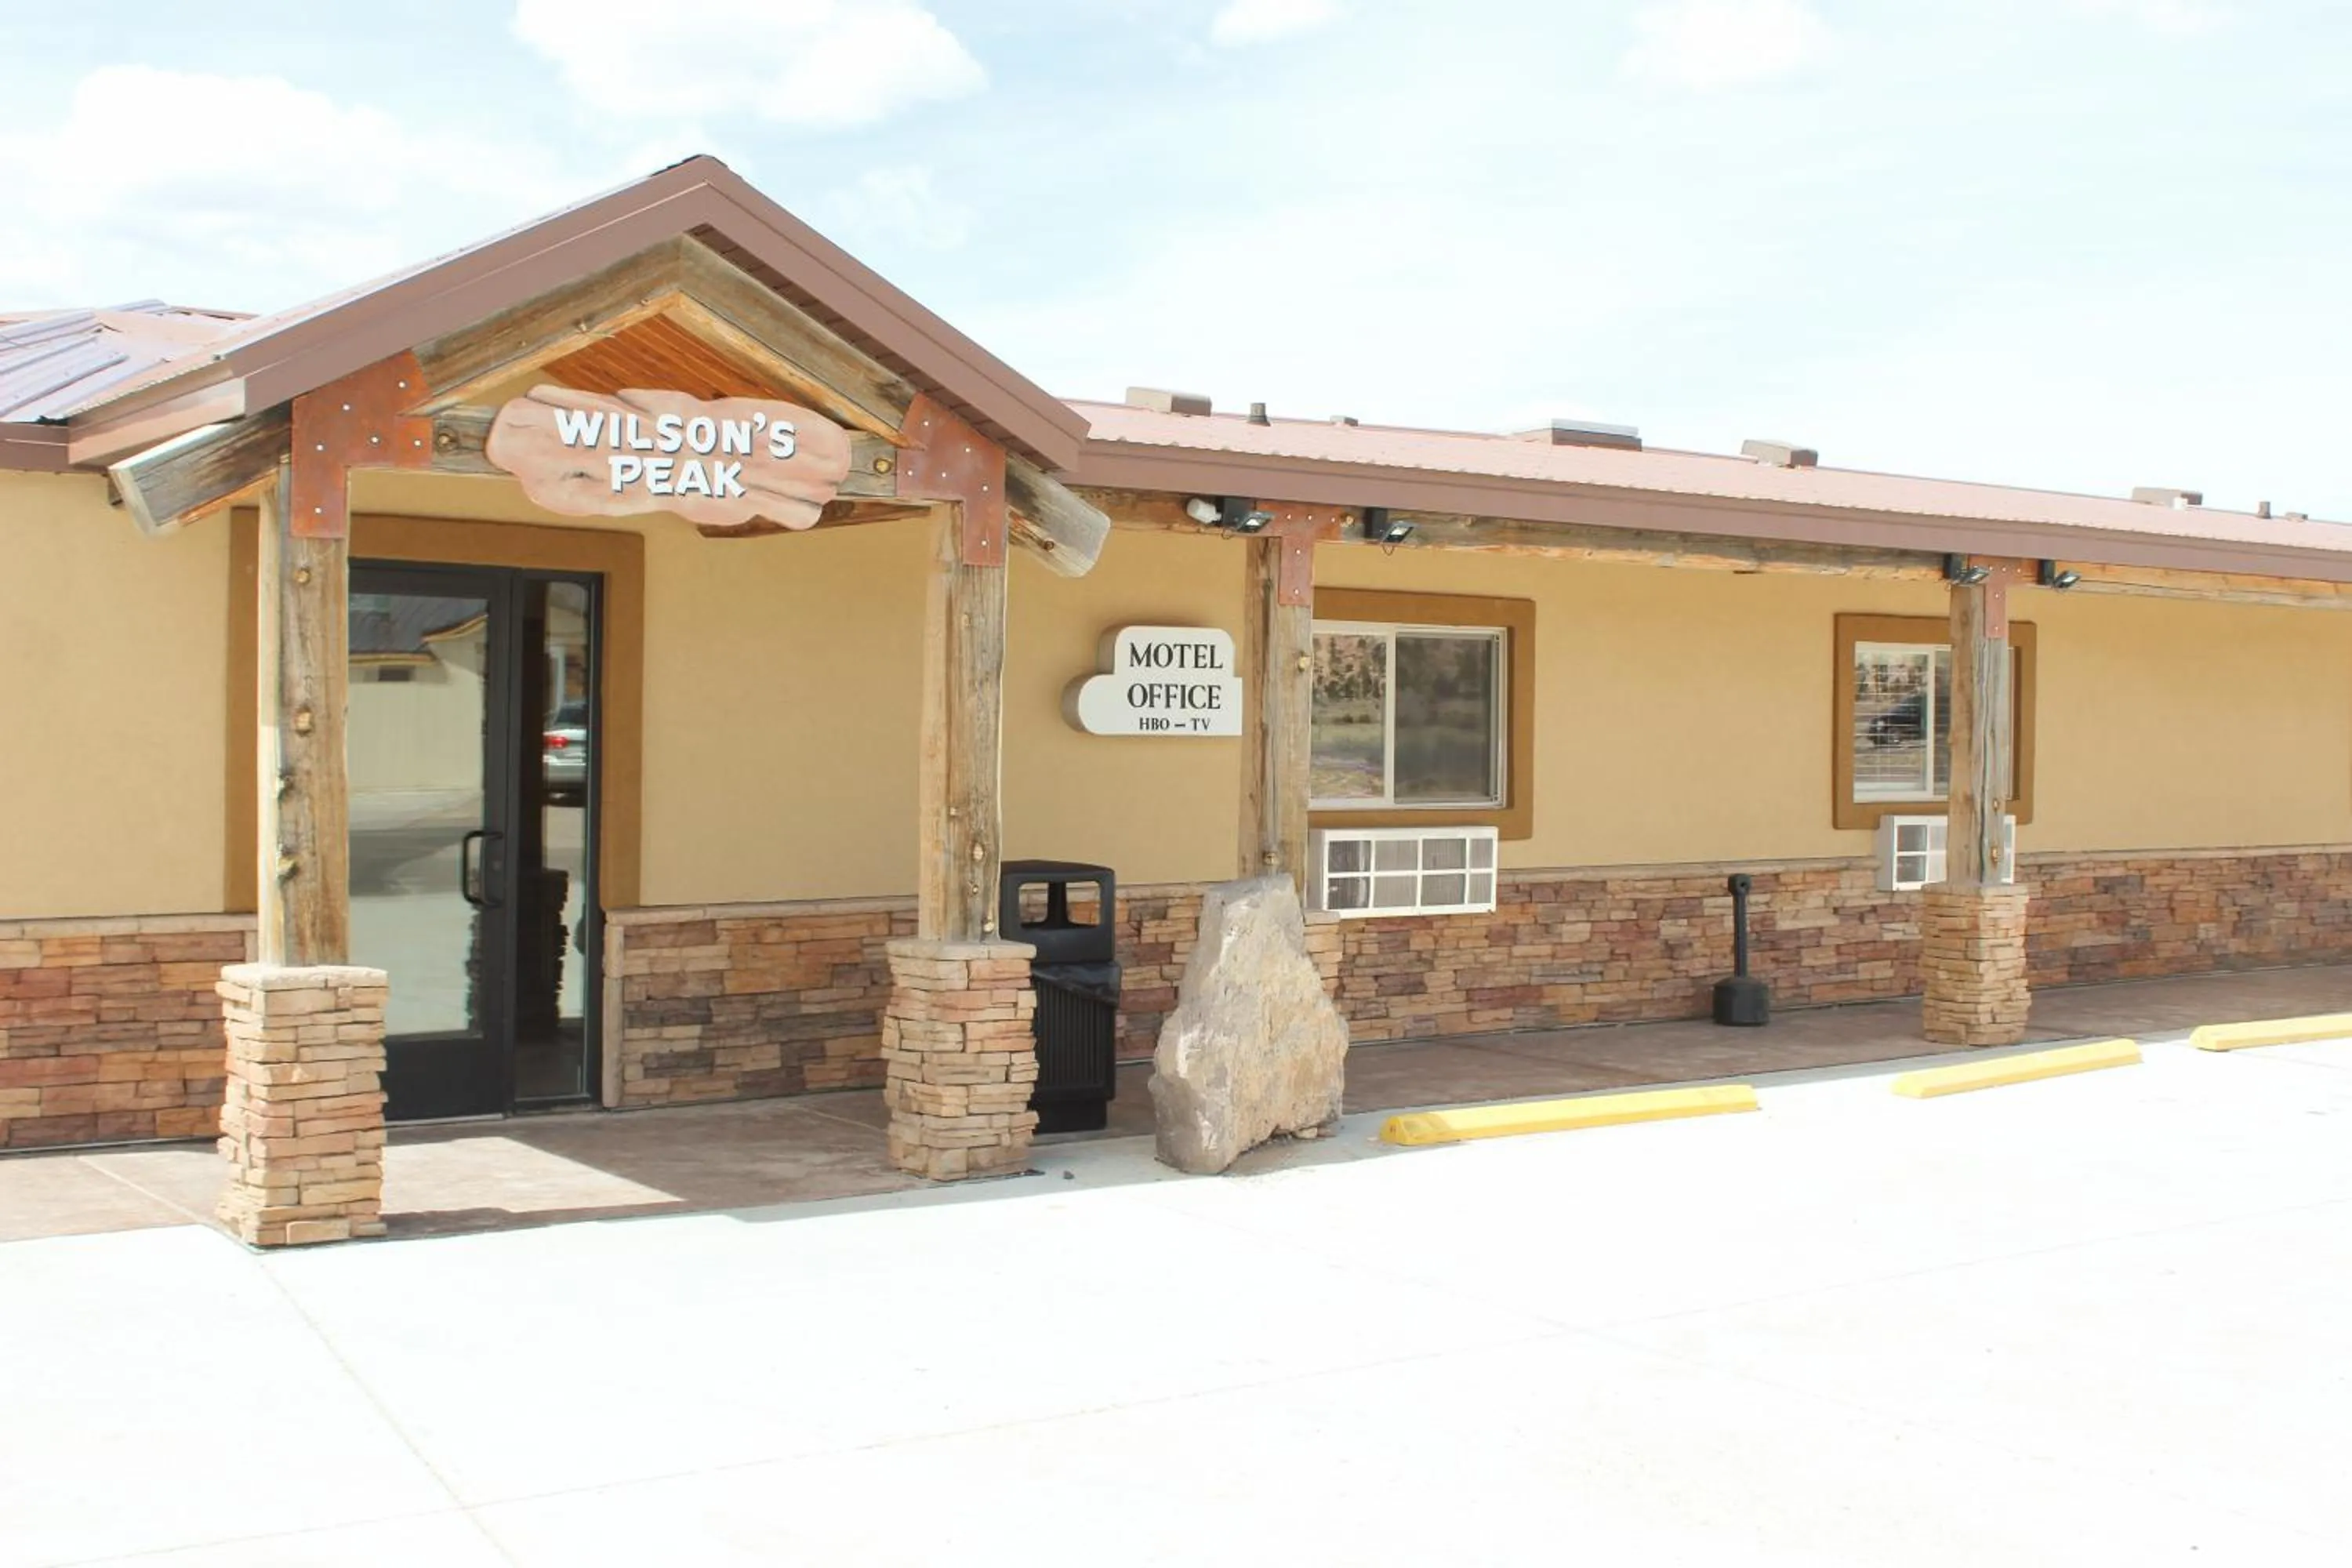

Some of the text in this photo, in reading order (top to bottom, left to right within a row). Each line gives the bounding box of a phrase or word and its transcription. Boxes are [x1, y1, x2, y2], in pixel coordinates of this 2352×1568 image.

[553, 408, 797, 459] WILSON'S
[608, 455, 747, 497] PEAK
[1129, 642, 1223, 669] MOTEL
[1127, 683, 1221, 710] OFFICE
[1138, 717, 1170, 731] HBO
[1189, 717, 1211, 731] TV
